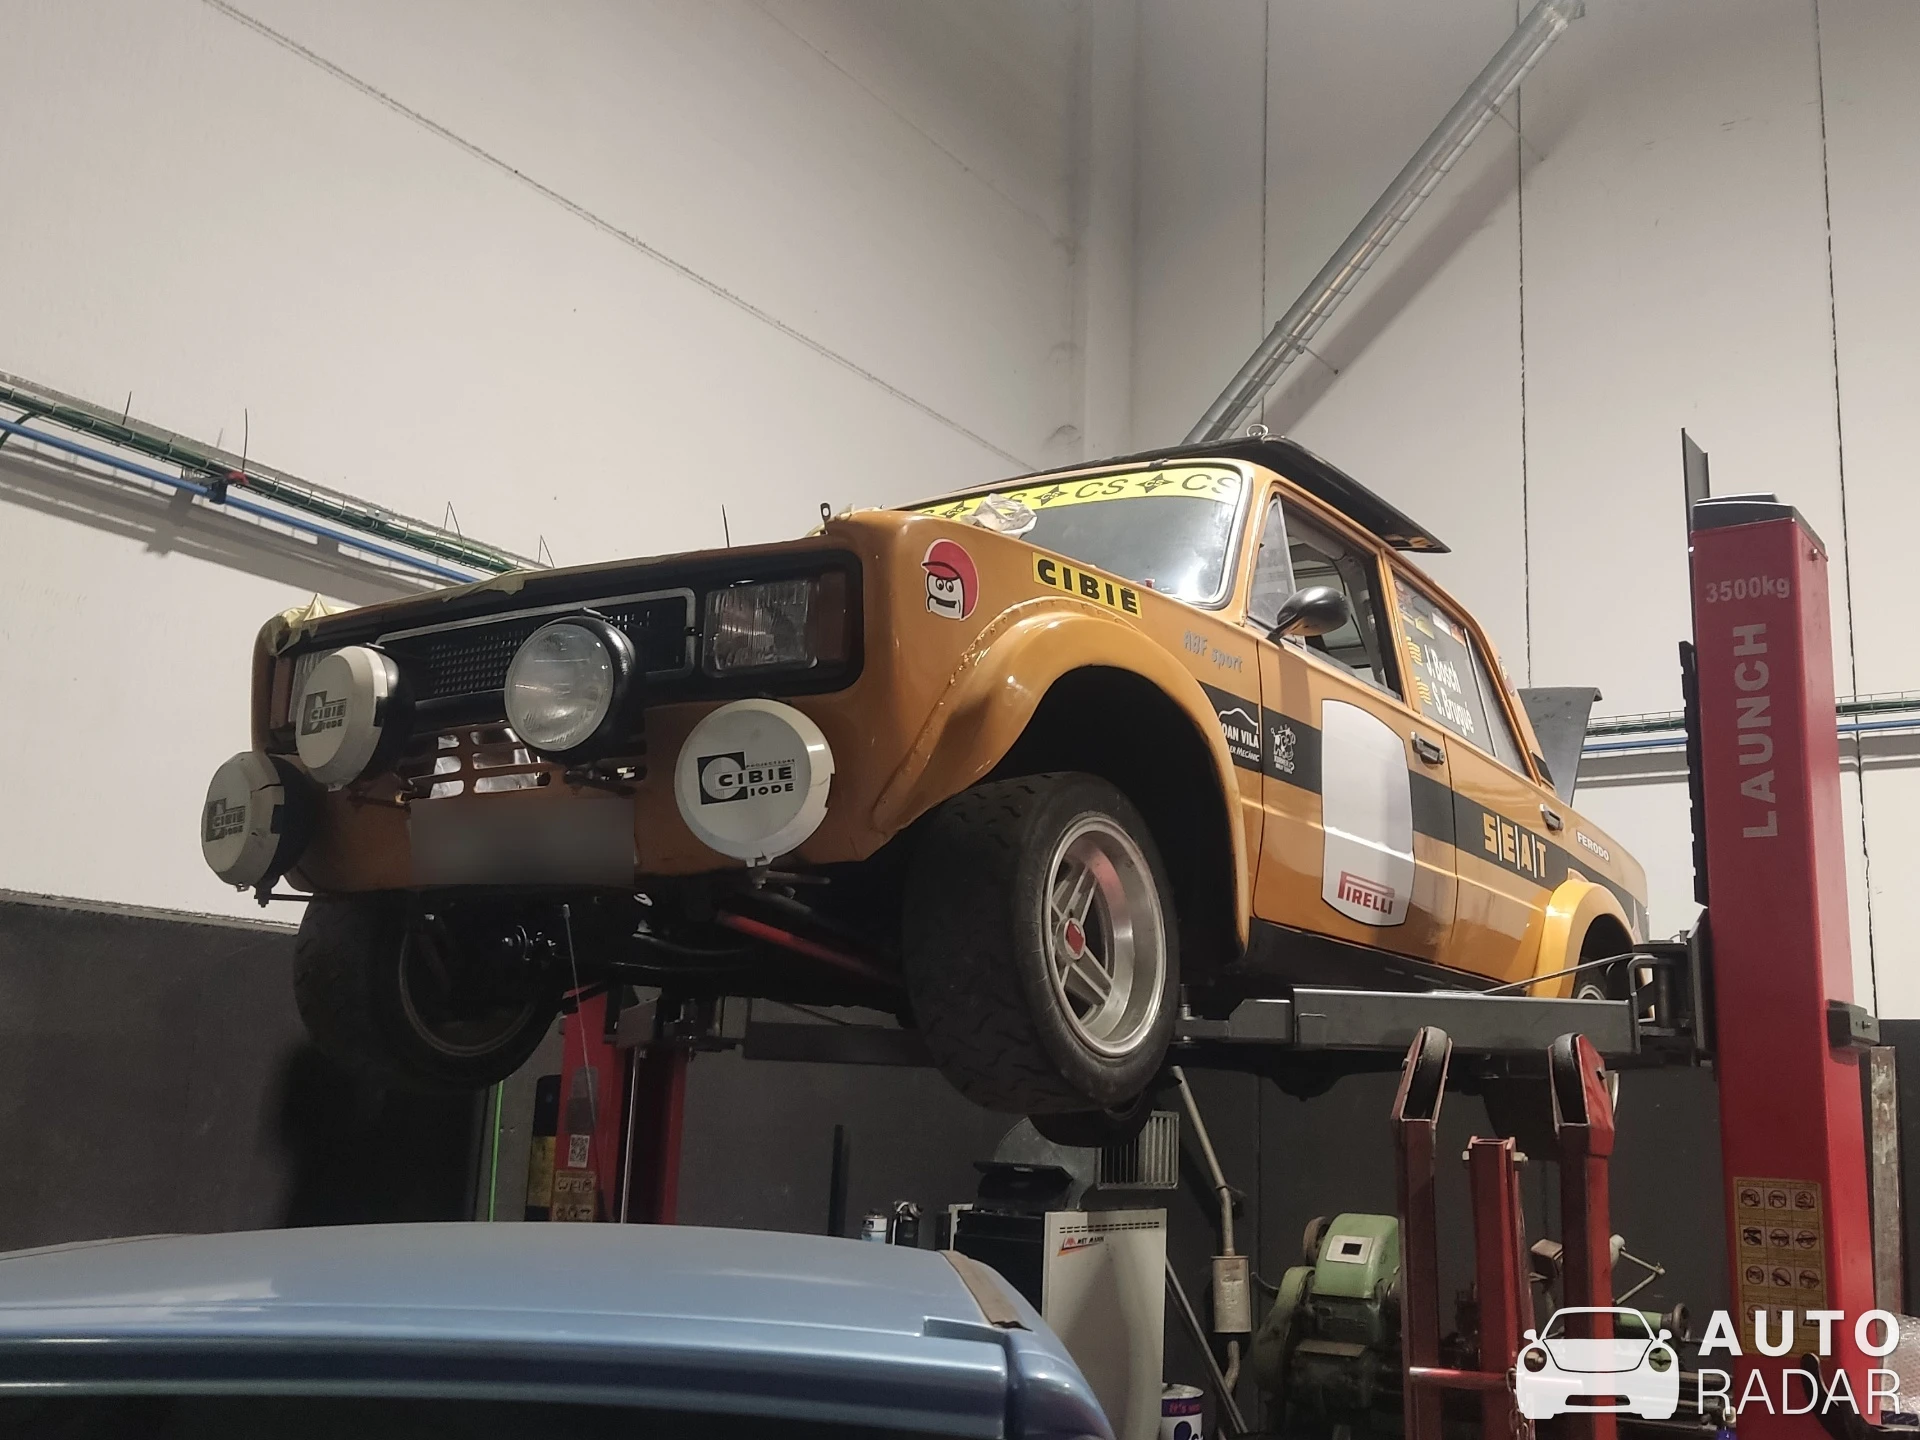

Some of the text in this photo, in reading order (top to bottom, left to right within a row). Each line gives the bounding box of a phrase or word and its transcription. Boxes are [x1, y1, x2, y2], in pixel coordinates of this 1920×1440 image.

[1075, 479, 1129, 498] CS
[1706, 575, 1791, 603] 3500kg
[1211, 647, 1243, 673] sport
[1220, 722, 1239, 742] OAN
[1733, 623, 1778, 838] LAUNCH
[718, 766, 793, 787] CIBIE
[750, 782, 794, 797] IODE
[1576, 831, 1610, 862] FERODO
[1337, 871, 1396, 915] PIRELLI
